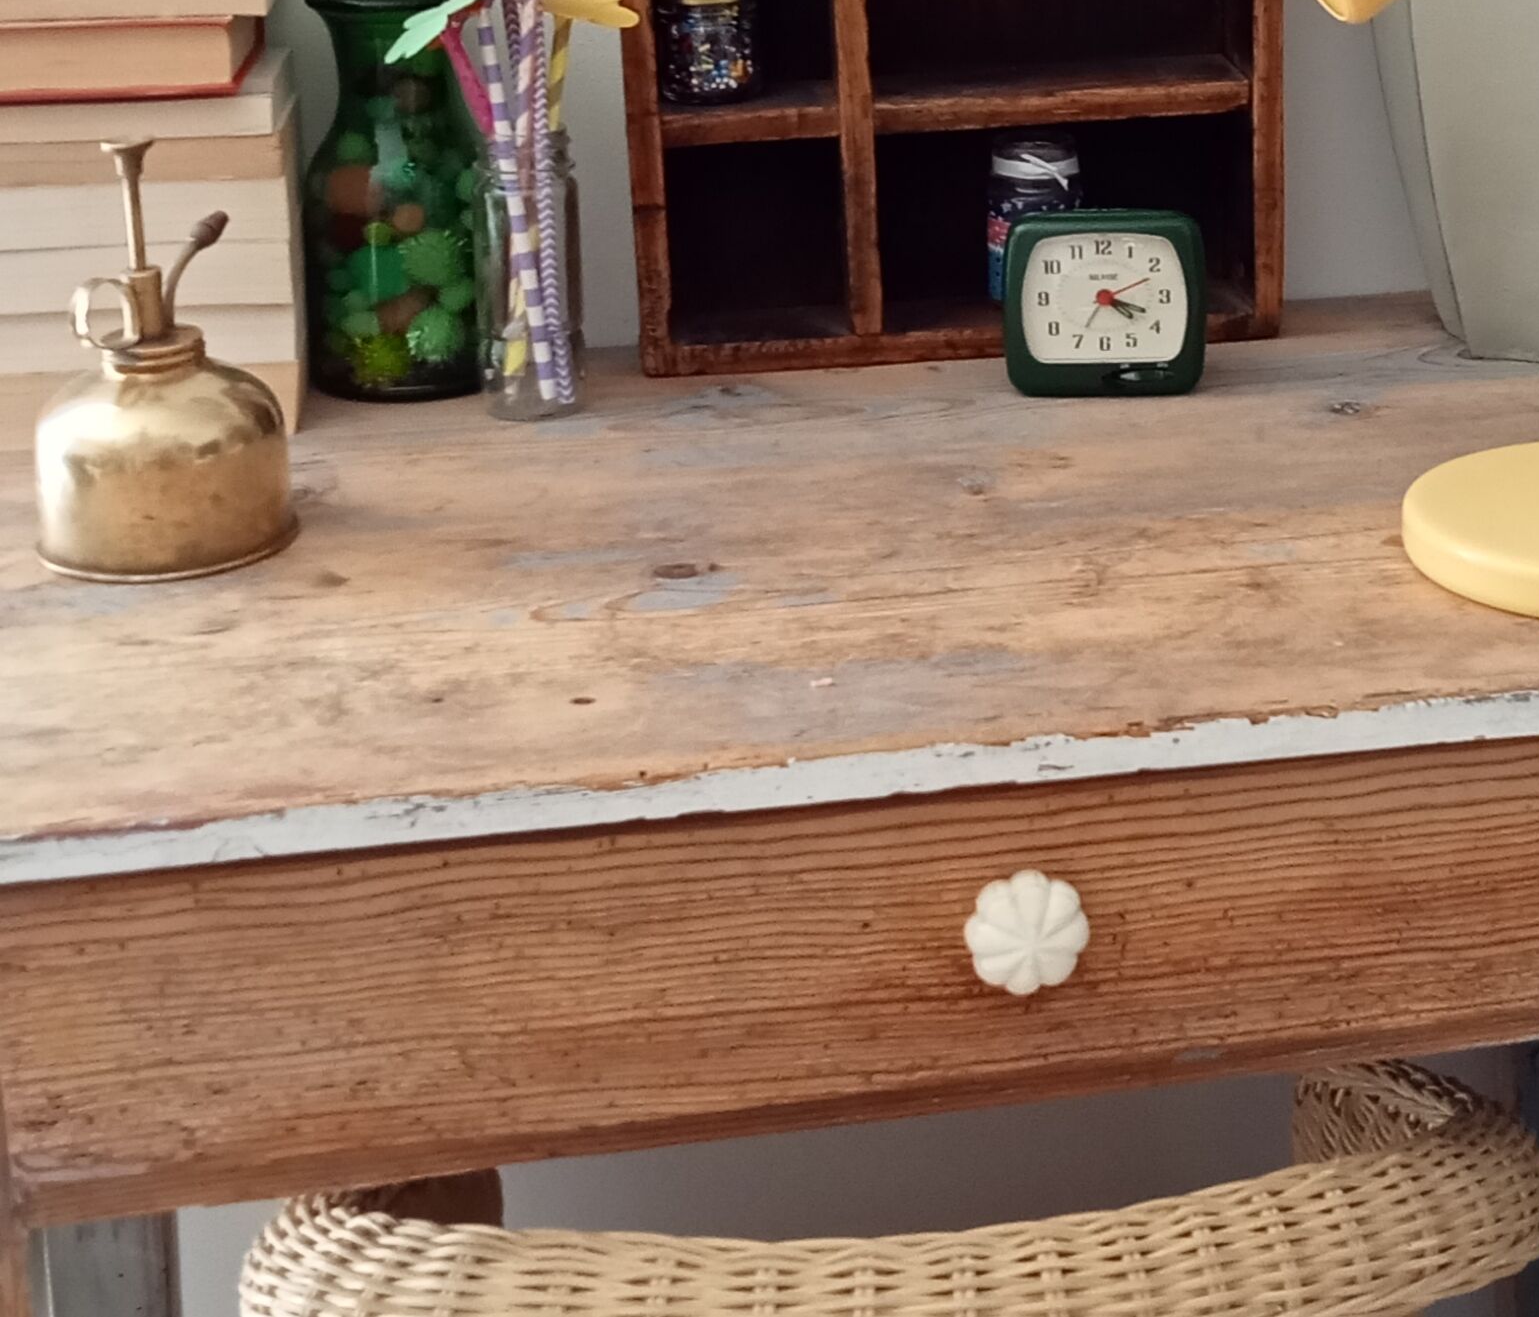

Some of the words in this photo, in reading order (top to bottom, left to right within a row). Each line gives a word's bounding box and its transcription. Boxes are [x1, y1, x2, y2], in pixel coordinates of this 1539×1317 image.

[1069, 245, 1083, 260] 11
[1094, 239, 1112, 255] 12
[1127, 246, 1133, 259] 1
[1042, 260, 1061, 275] 10
[1148, 257, 1161, 273] 2
[1037, 291, 1050, 306] 9
[1158, 289, 1171, 304] 3
[1047, 321, 1060, 336] 8
[1149, 320, 1161, 334] 4
[1072, 334, 1084, 349] 7
[1099, 336, 1111, 352] 6
[1125, 333, 1138, 348] 5
